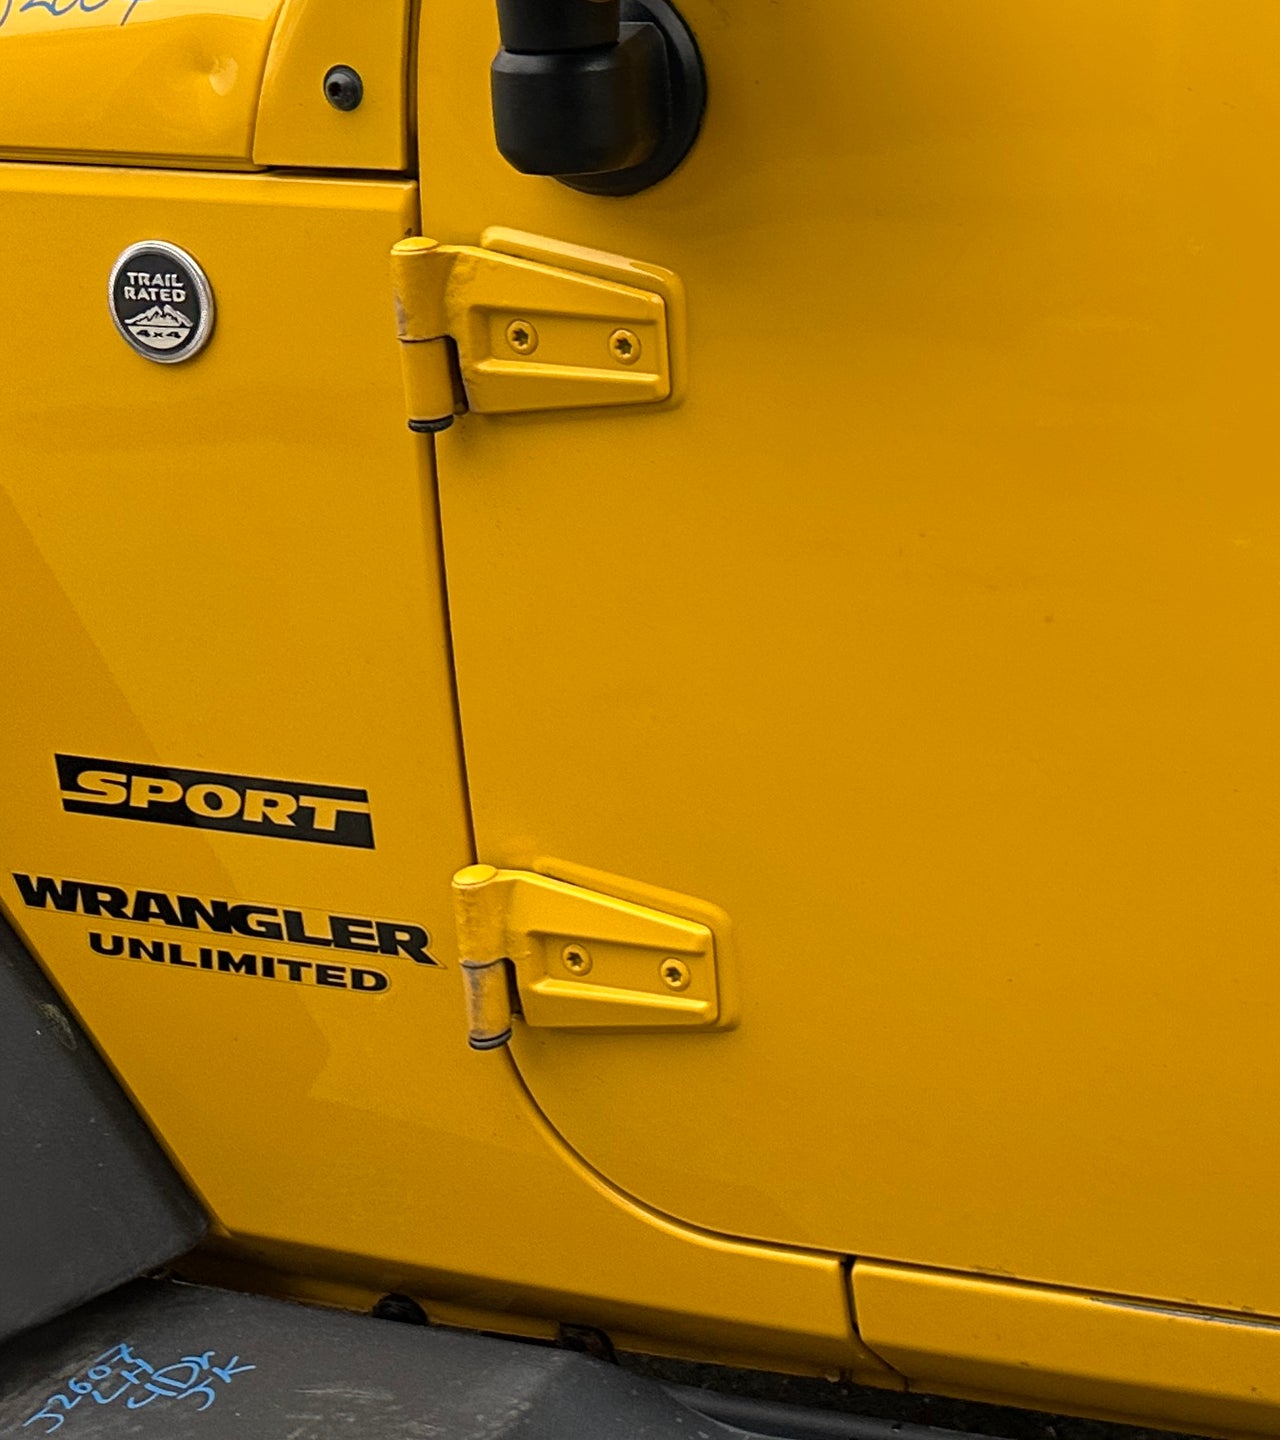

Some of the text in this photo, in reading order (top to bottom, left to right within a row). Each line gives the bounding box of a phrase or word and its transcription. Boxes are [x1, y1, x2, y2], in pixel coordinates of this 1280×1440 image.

[123, 286, 187, 303] RATED
[127, 271, 184, 287] TRAIL
[76, 770, 370, 832] SPORT
[12, 872, 442, 968] WRANGLER
[88, 932, 391, 993] UNLIMITED
[22, 1343, 134, 1434] J2607
